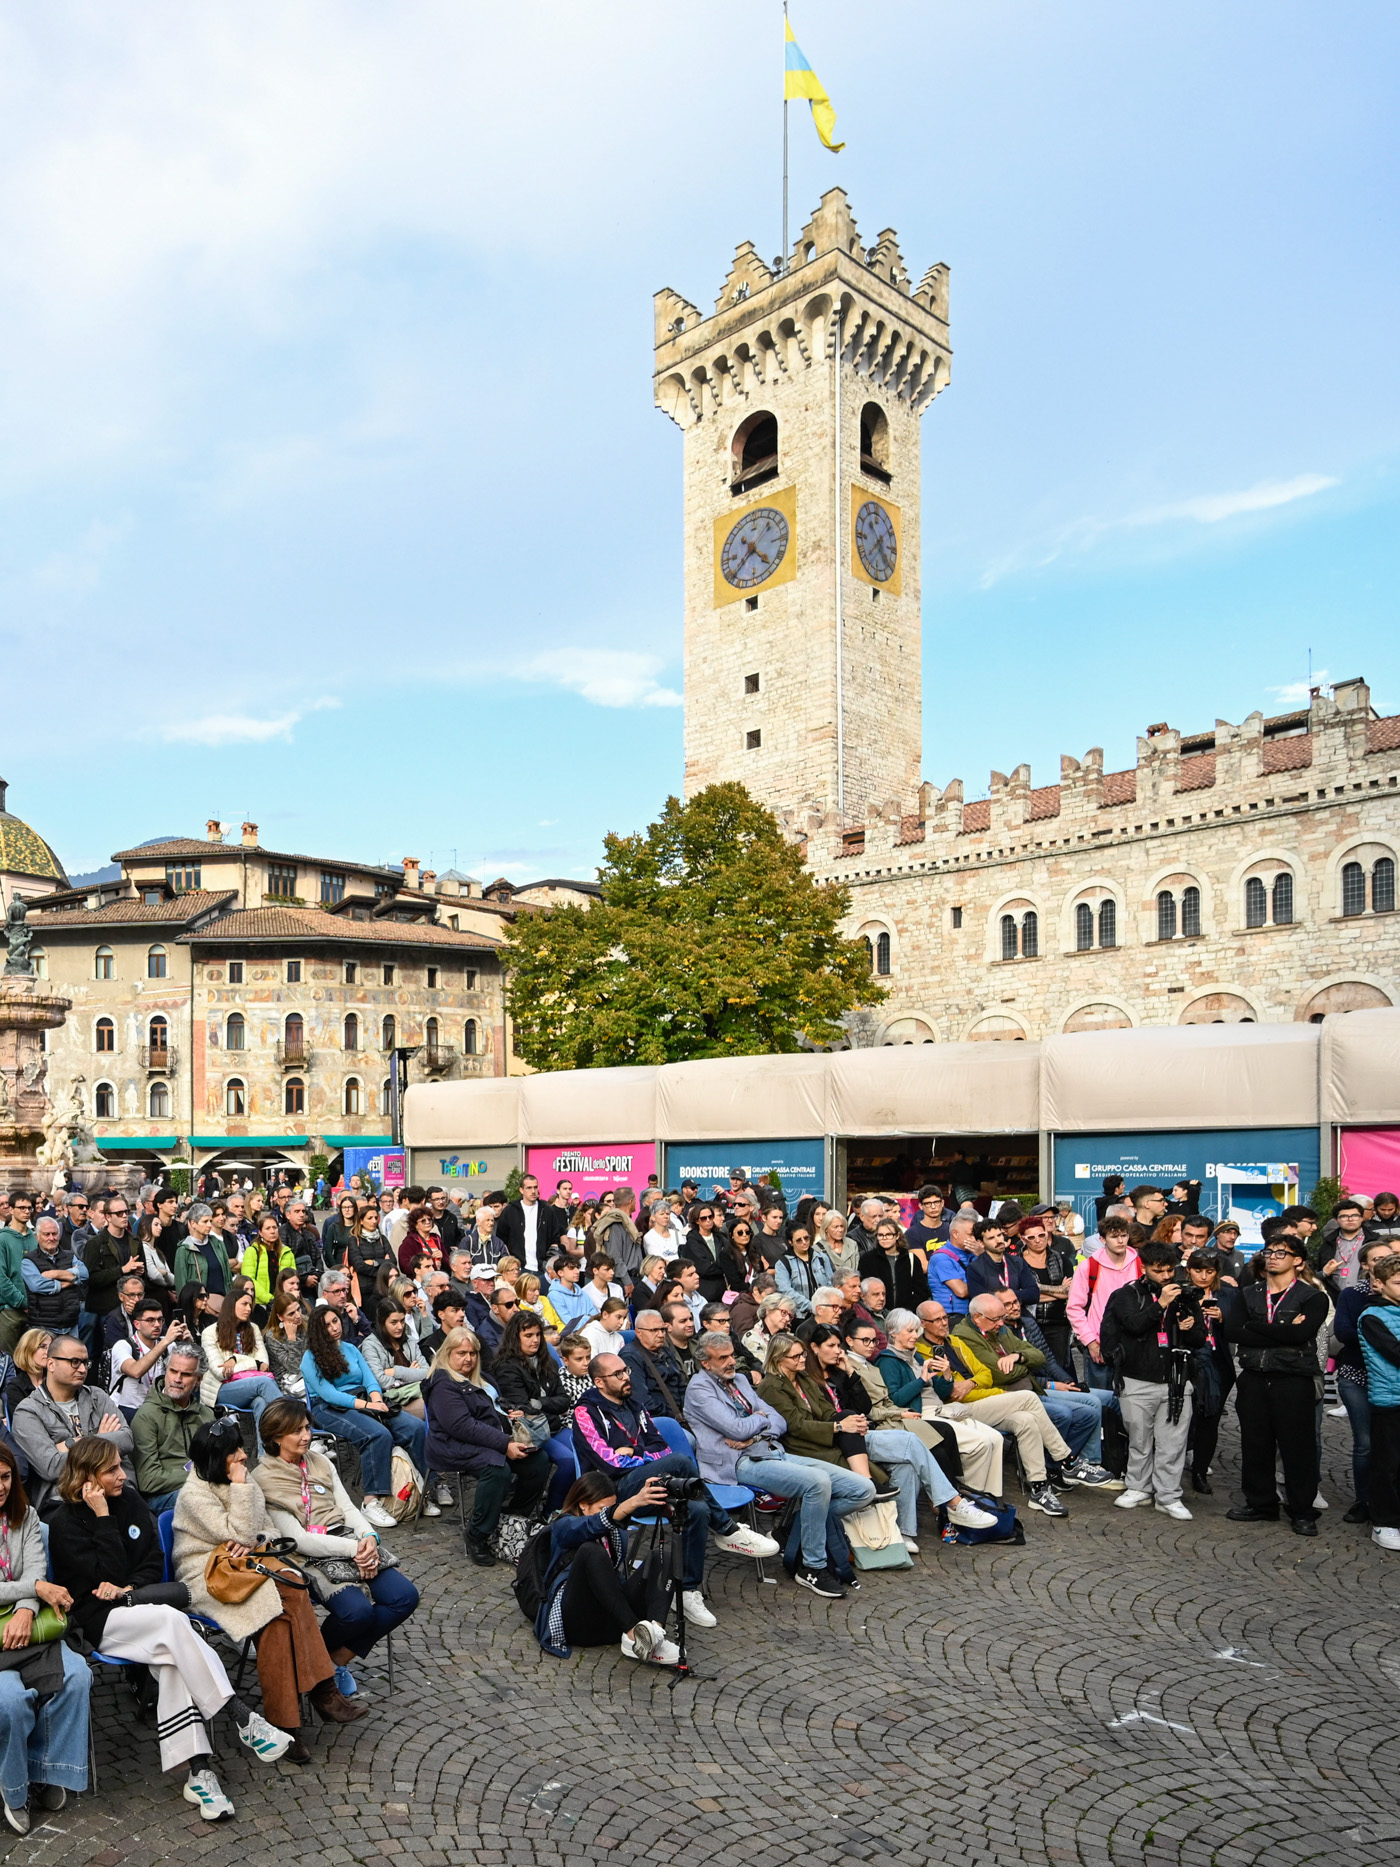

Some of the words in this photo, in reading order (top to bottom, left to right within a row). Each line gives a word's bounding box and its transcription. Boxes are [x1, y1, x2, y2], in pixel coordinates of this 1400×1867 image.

[439, 1159, 488, 1178] TRENTINO
[556, 1156, 595, 1172] FESTIVAL
[604, 1155, 633, 1172] SPORT
[1091, 1164, 1121, 1172] GRUPPO
[1123, 1164, 1148, 1172] CASSA
[1148, 1164, 1187, 1172] CENTRALE
[679, 1166, 730, 1179] BOOKSTORE
